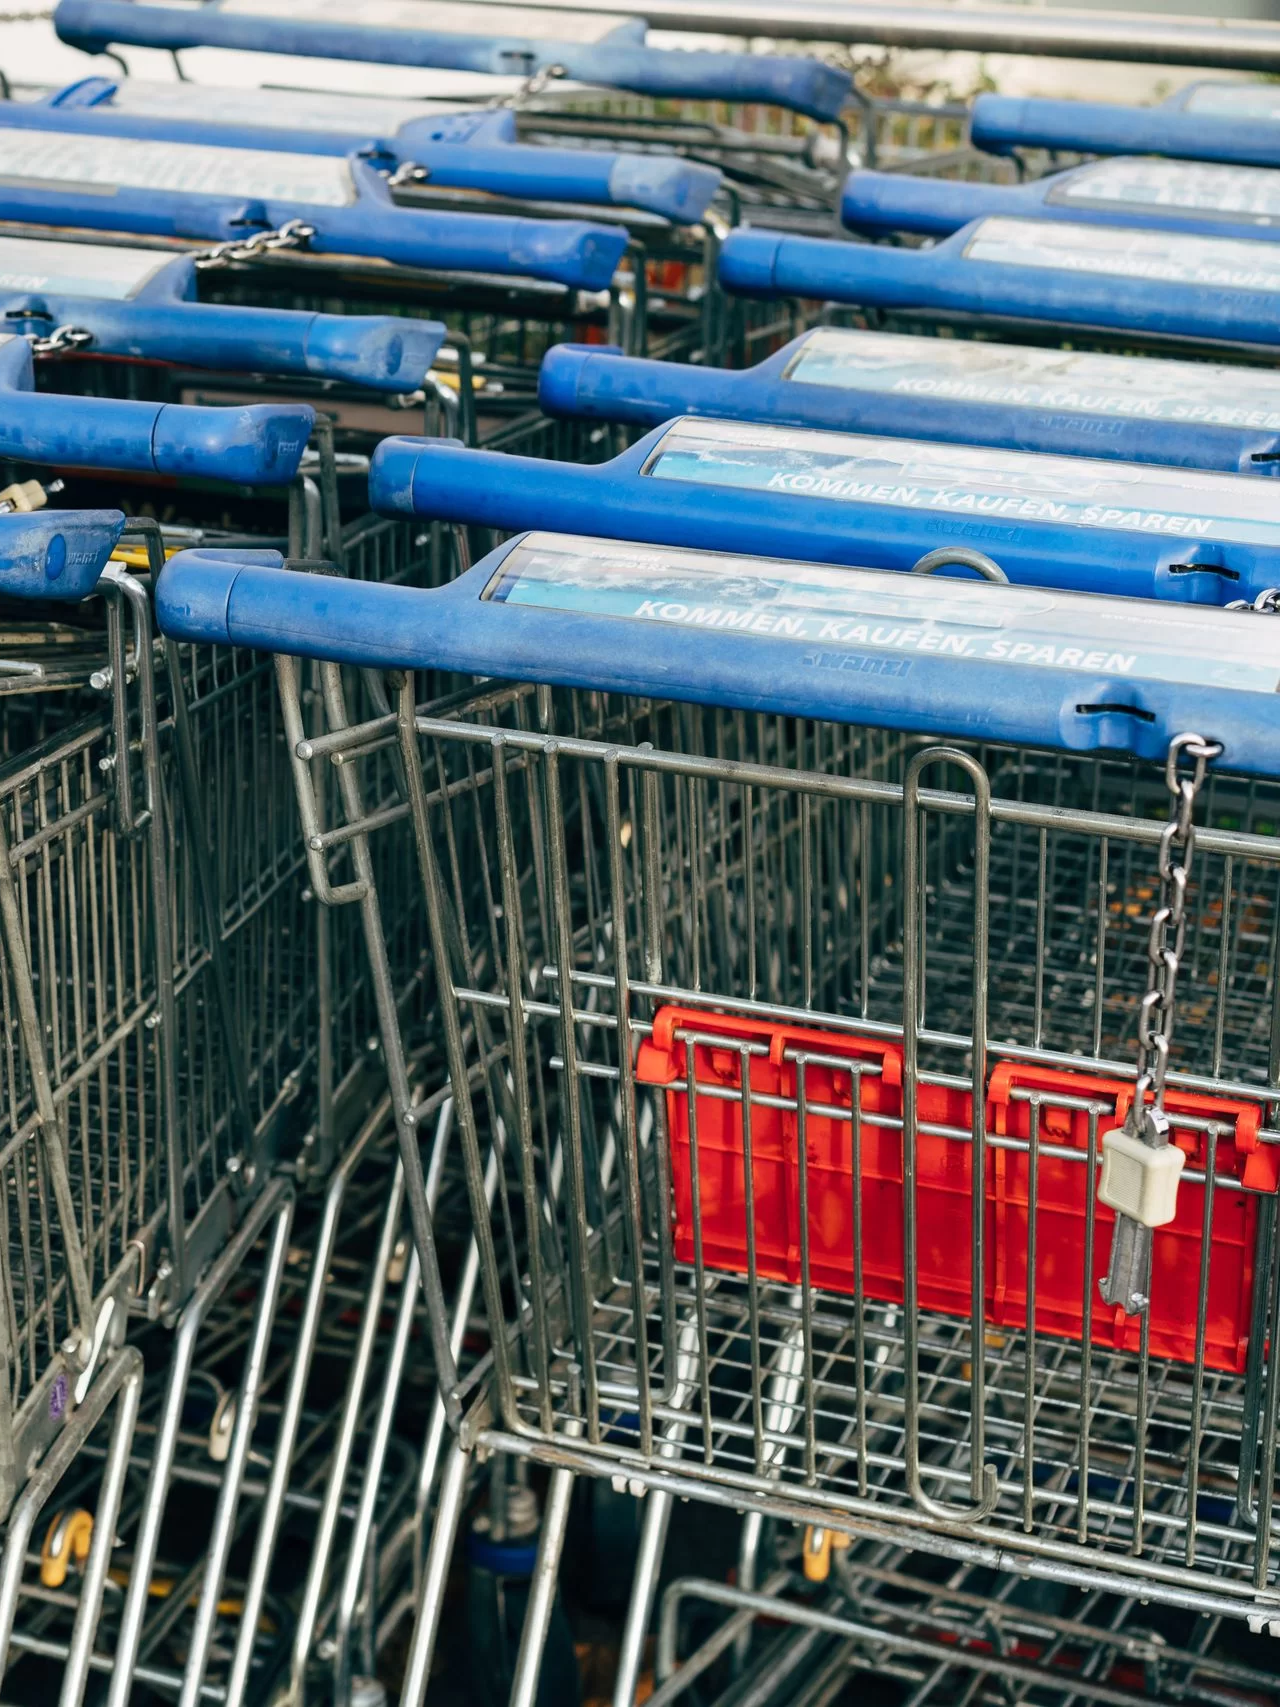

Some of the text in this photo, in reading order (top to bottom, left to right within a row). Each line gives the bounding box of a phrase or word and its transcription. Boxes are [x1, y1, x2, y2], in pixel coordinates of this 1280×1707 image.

[893, 378, 1030, 402] KOMMEN,
[1040, 388, 1164, 417] KAUFEN,
[768, 471, 1214, 534] KOMMEN, KAUFEN, SPAREN
[634, 599, 807, 637] KOMMEN,
[818, 617, 977, 658] KAUFEN,
[985, 639, 1137, 673] SPAREN
